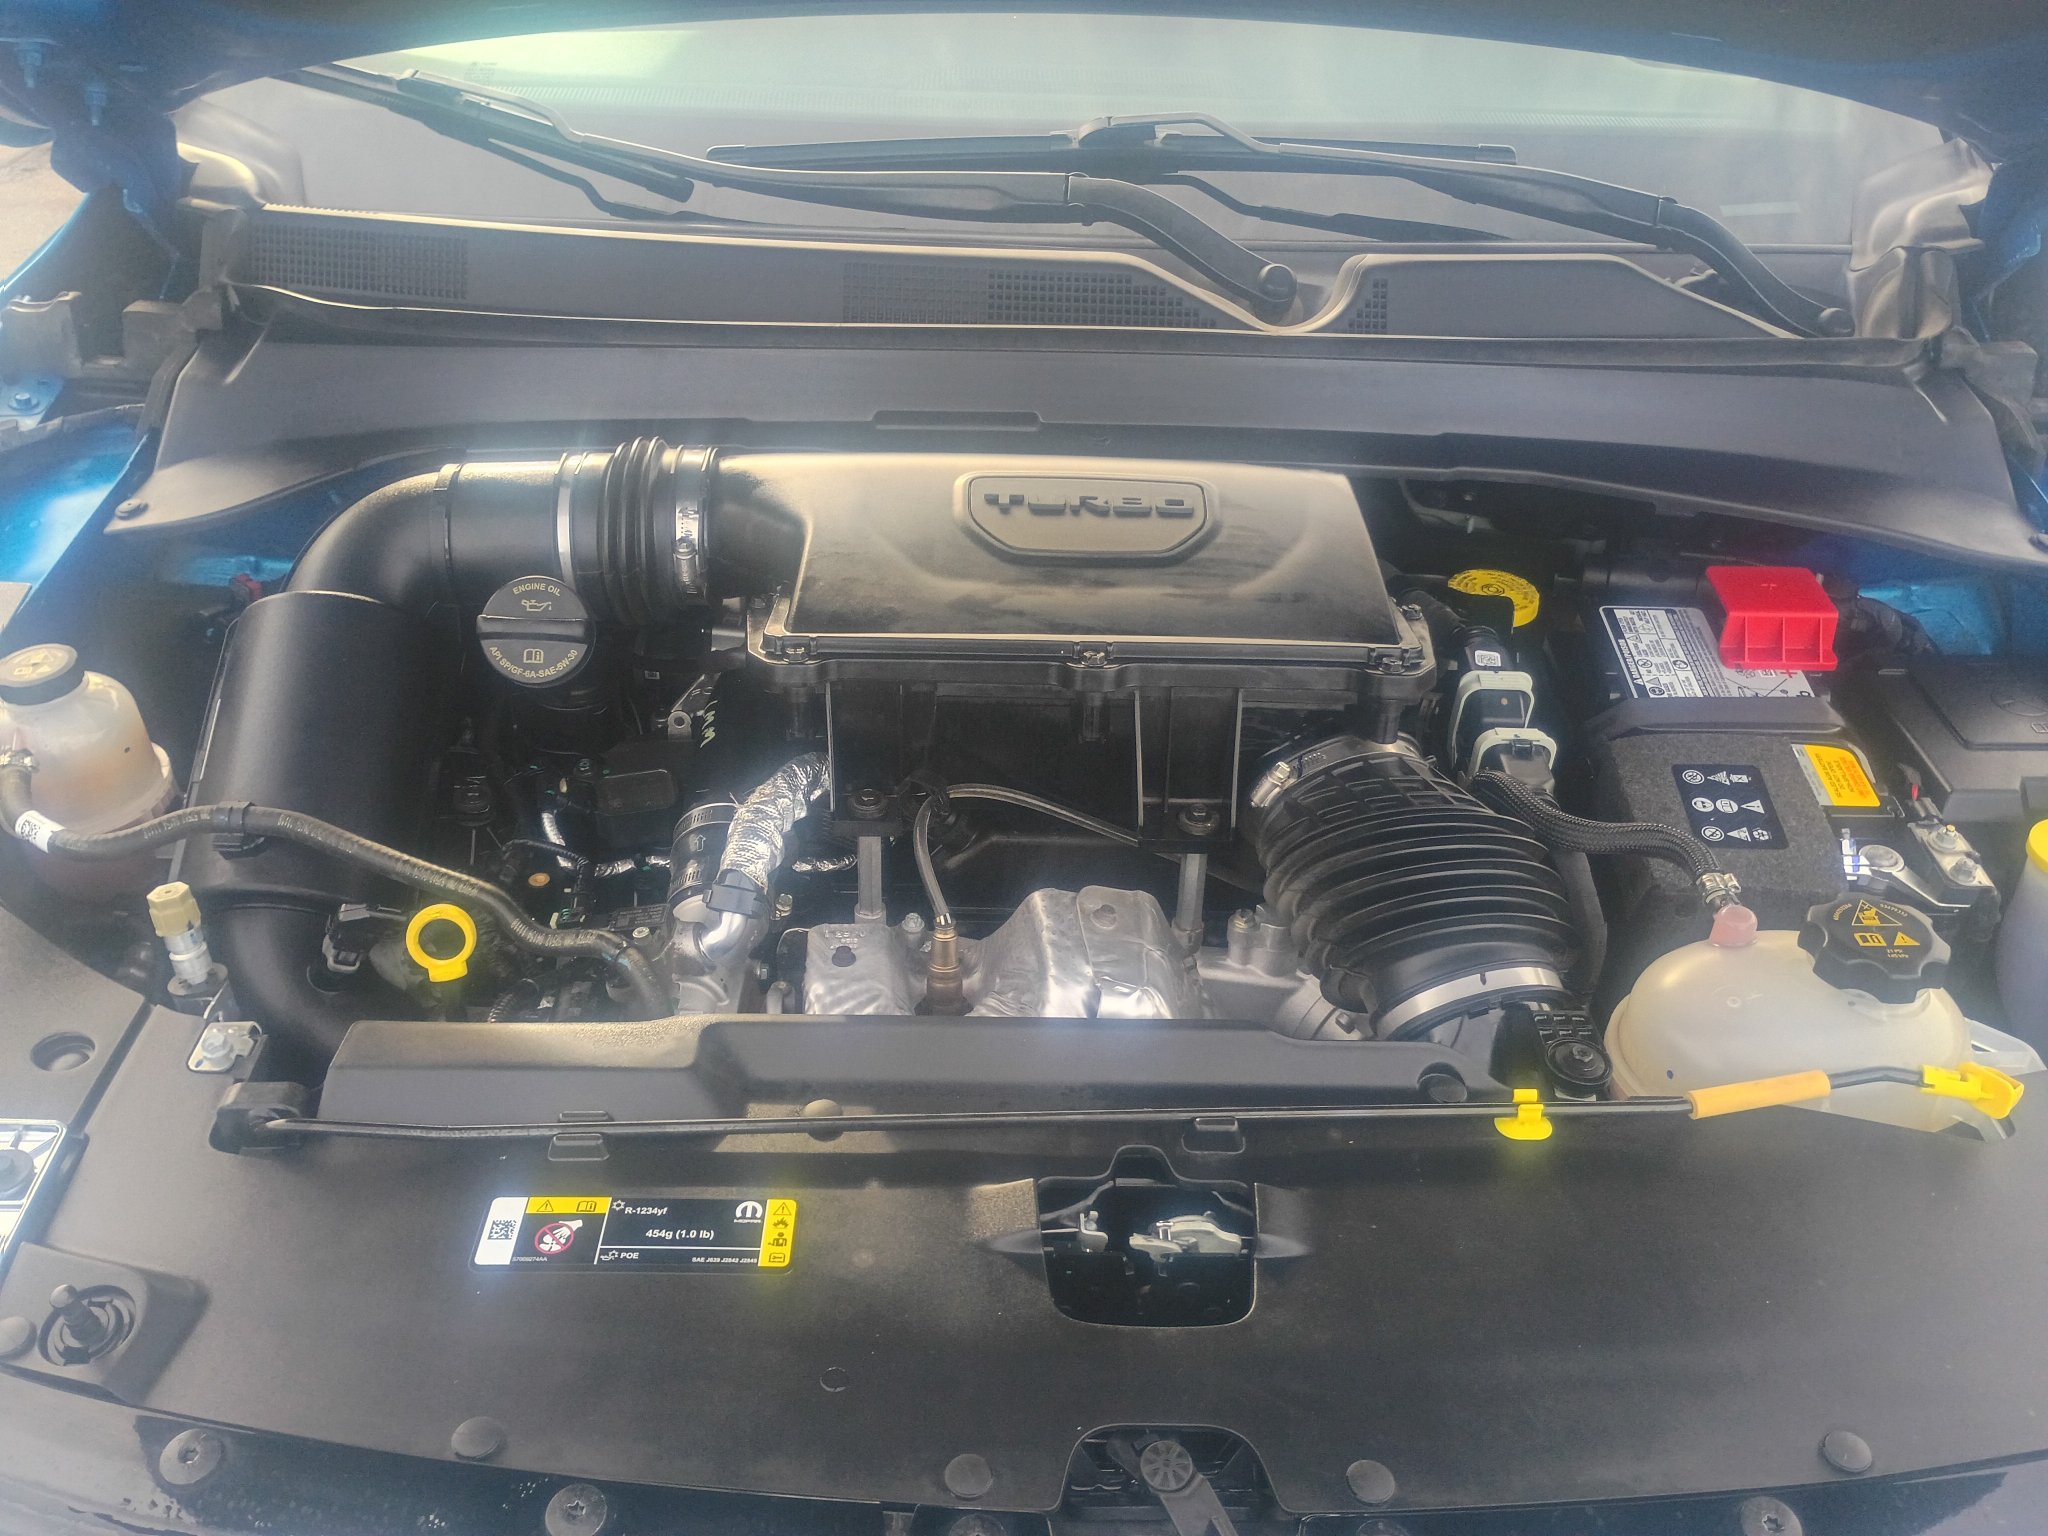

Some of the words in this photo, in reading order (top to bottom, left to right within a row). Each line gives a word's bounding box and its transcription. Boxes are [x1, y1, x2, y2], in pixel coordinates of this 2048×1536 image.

[512, 582, 546, 595] ENGINE
[547, 585, 561, 597] OIL
[489, 646, 502, 661] API
[624, 1206, 668, 1216] R-1234yf
[645, 1229, 673, 1240] 454g
[675, 1230, 697, 1240] (1.0
[699, 1230, 715, 1240] lb)
[620, 1252, 640, 1260] POE
